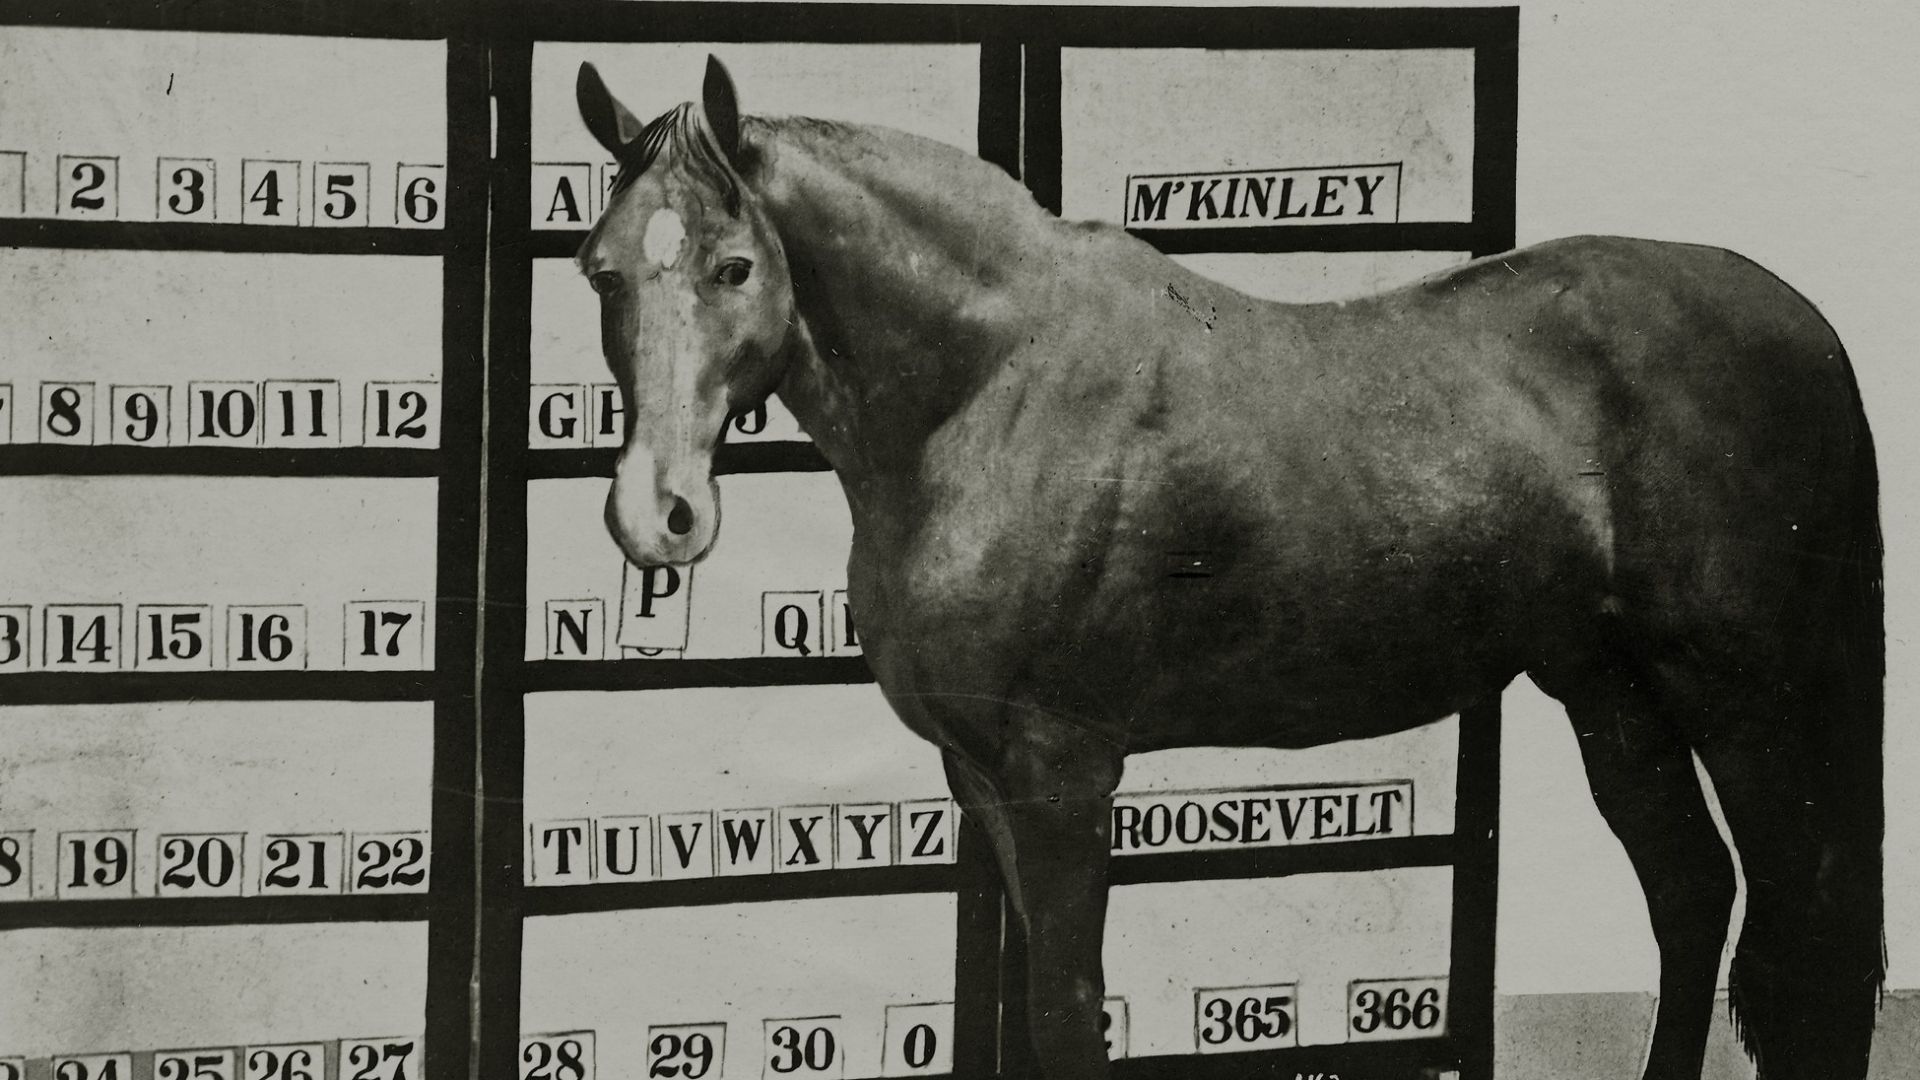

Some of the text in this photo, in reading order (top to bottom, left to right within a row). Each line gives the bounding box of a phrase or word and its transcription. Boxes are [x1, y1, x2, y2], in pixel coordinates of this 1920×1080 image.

[71, 163, 437, 223] 2 3 4 5 6
[546, 177, 581, 221] A
[47, 387, 427, 442] 8 9 10 11 12
[539, 393, 577, 438] G
[636, 566, 680, 618] P
[57, 615, 112, 663] 14
[148, 613, 201, 660] 15
[238, 614, 292, 662] 16
[360, 610, 411, 656] 17
[554, 609, 592, 655] N
[775, 605, 811, 656] Q
[544, 810, 943, 875] T U V W X Y Z
[1112, 790, 1402, 850] ROOSEVELT
[68, 837, 127, 888] 19
[163, 838, 234, 888] 20
[265, 840, 328, 888] 21
[357, 838, 425, 889] 22
[1202, 988, 1440, 1044] 365 366
[349, 1042, 413, 1080] 27
[524, 1040, 584, 1080] 28
[650, 1033, 713, 1079] 29
[771, 1027, 835, 1073] 30
